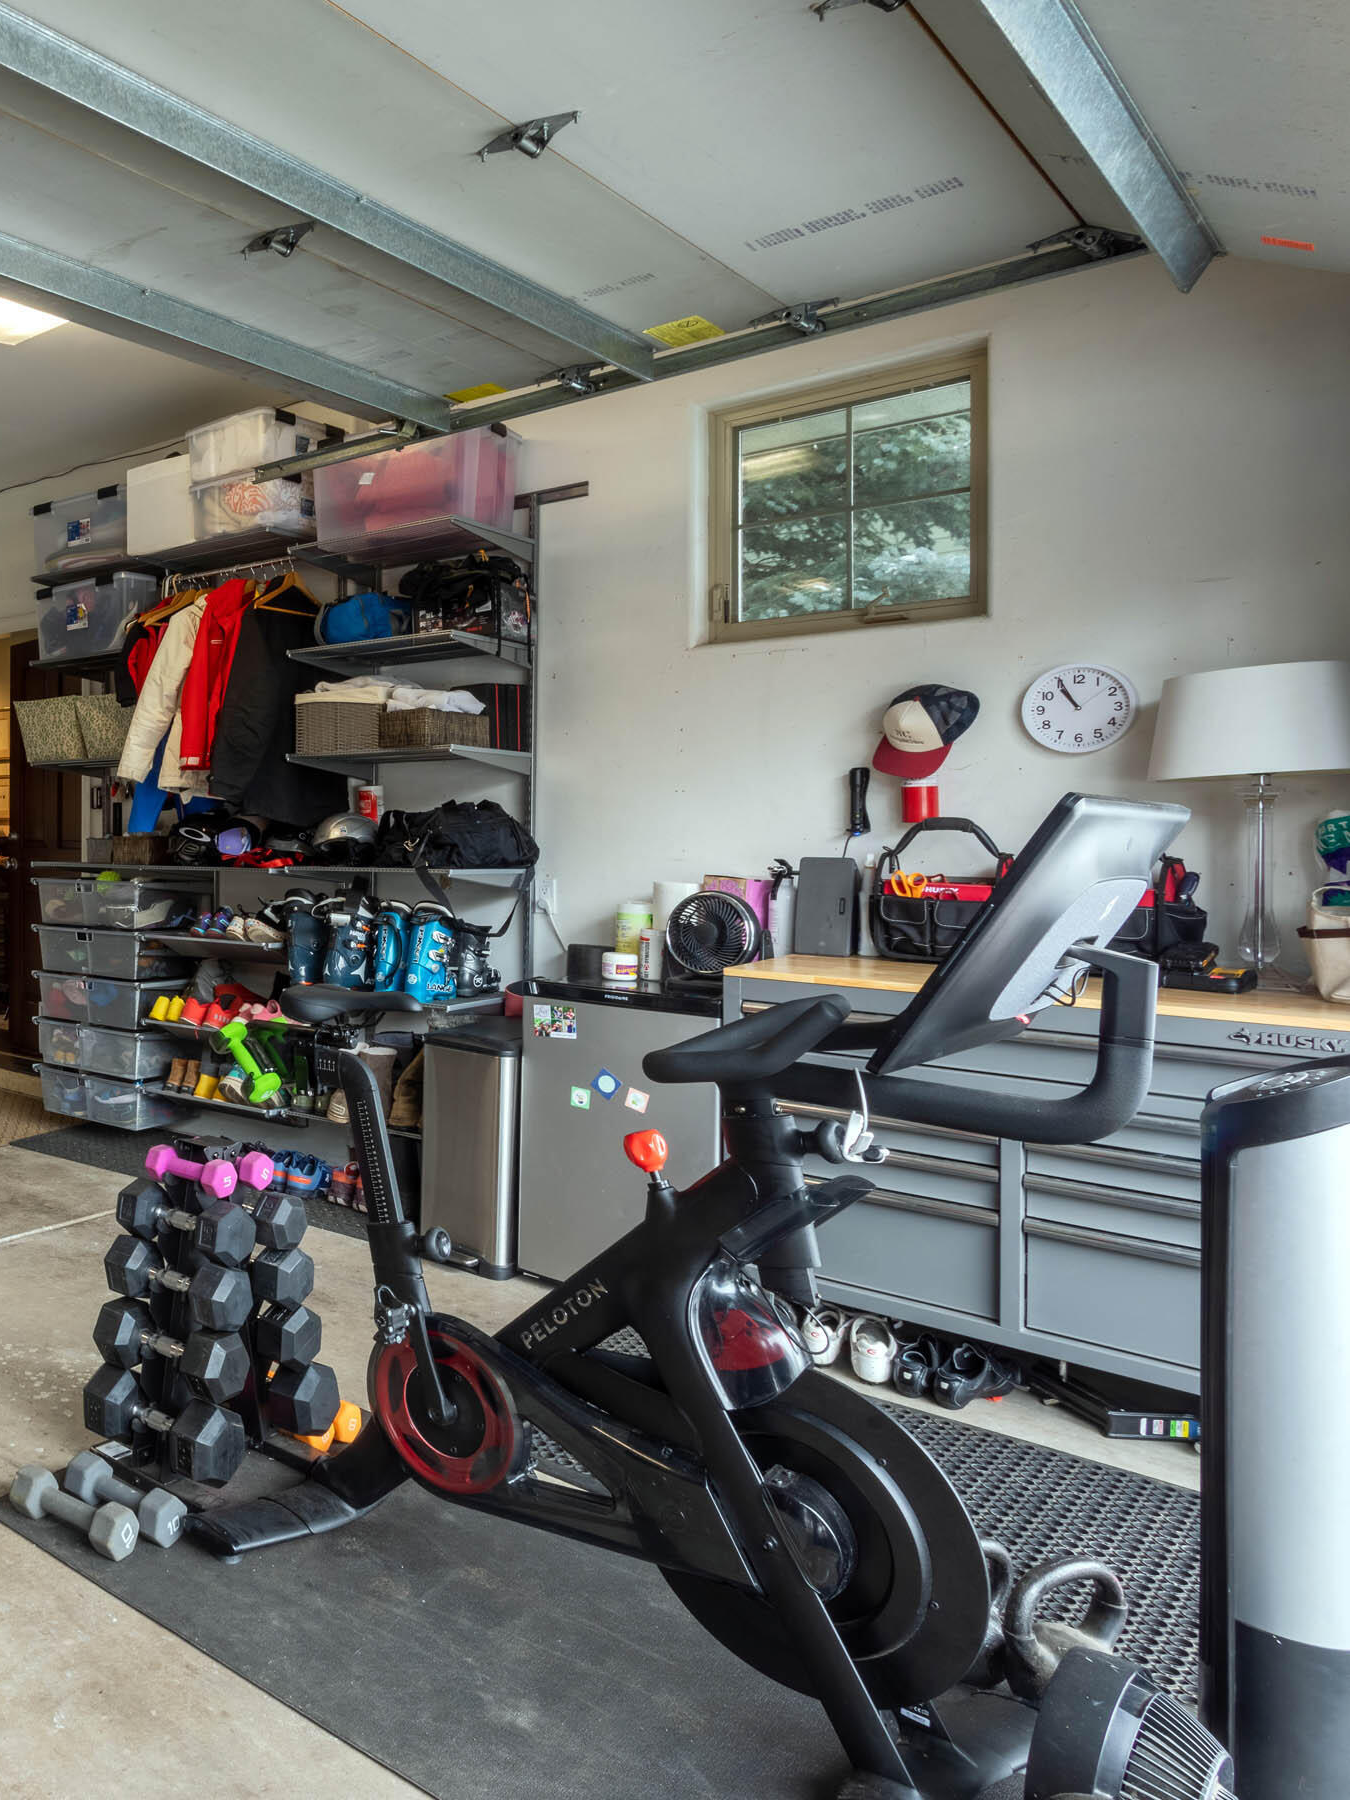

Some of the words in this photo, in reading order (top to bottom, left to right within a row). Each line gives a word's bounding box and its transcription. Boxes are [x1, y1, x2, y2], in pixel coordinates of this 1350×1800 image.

[1073, 674, 1086, 684] 12
[1096, 676, 1100, 687] 1
[1041, 691, 1055, 701] 10
[1107, 686, 1118, 697] 2
[1036, 705, 1046, 716] 9
[1113, 701, 1123, 711] 3
[1041, 719, 1051, 730] 8
[1107, 716, 1117, 727] 4
[1055, 729, 1065, 740] 7
[1074, 733, 1083, 743] 6
[1093, 728, 1103, 738] 5
[412, 924, 426, 964] LANGE
[426, 983, 453, 993] LANGE
[1259, 1031, 1347, 1054] HUSKY
[261, 1167, 270, 1181] 5
[222, 1175, 232, 1188] 5
[520, 1277, 609, 1350] PELOTON
[166, 1515, 181, 1536] 10
[120, 1522, 135, 1549] 10
